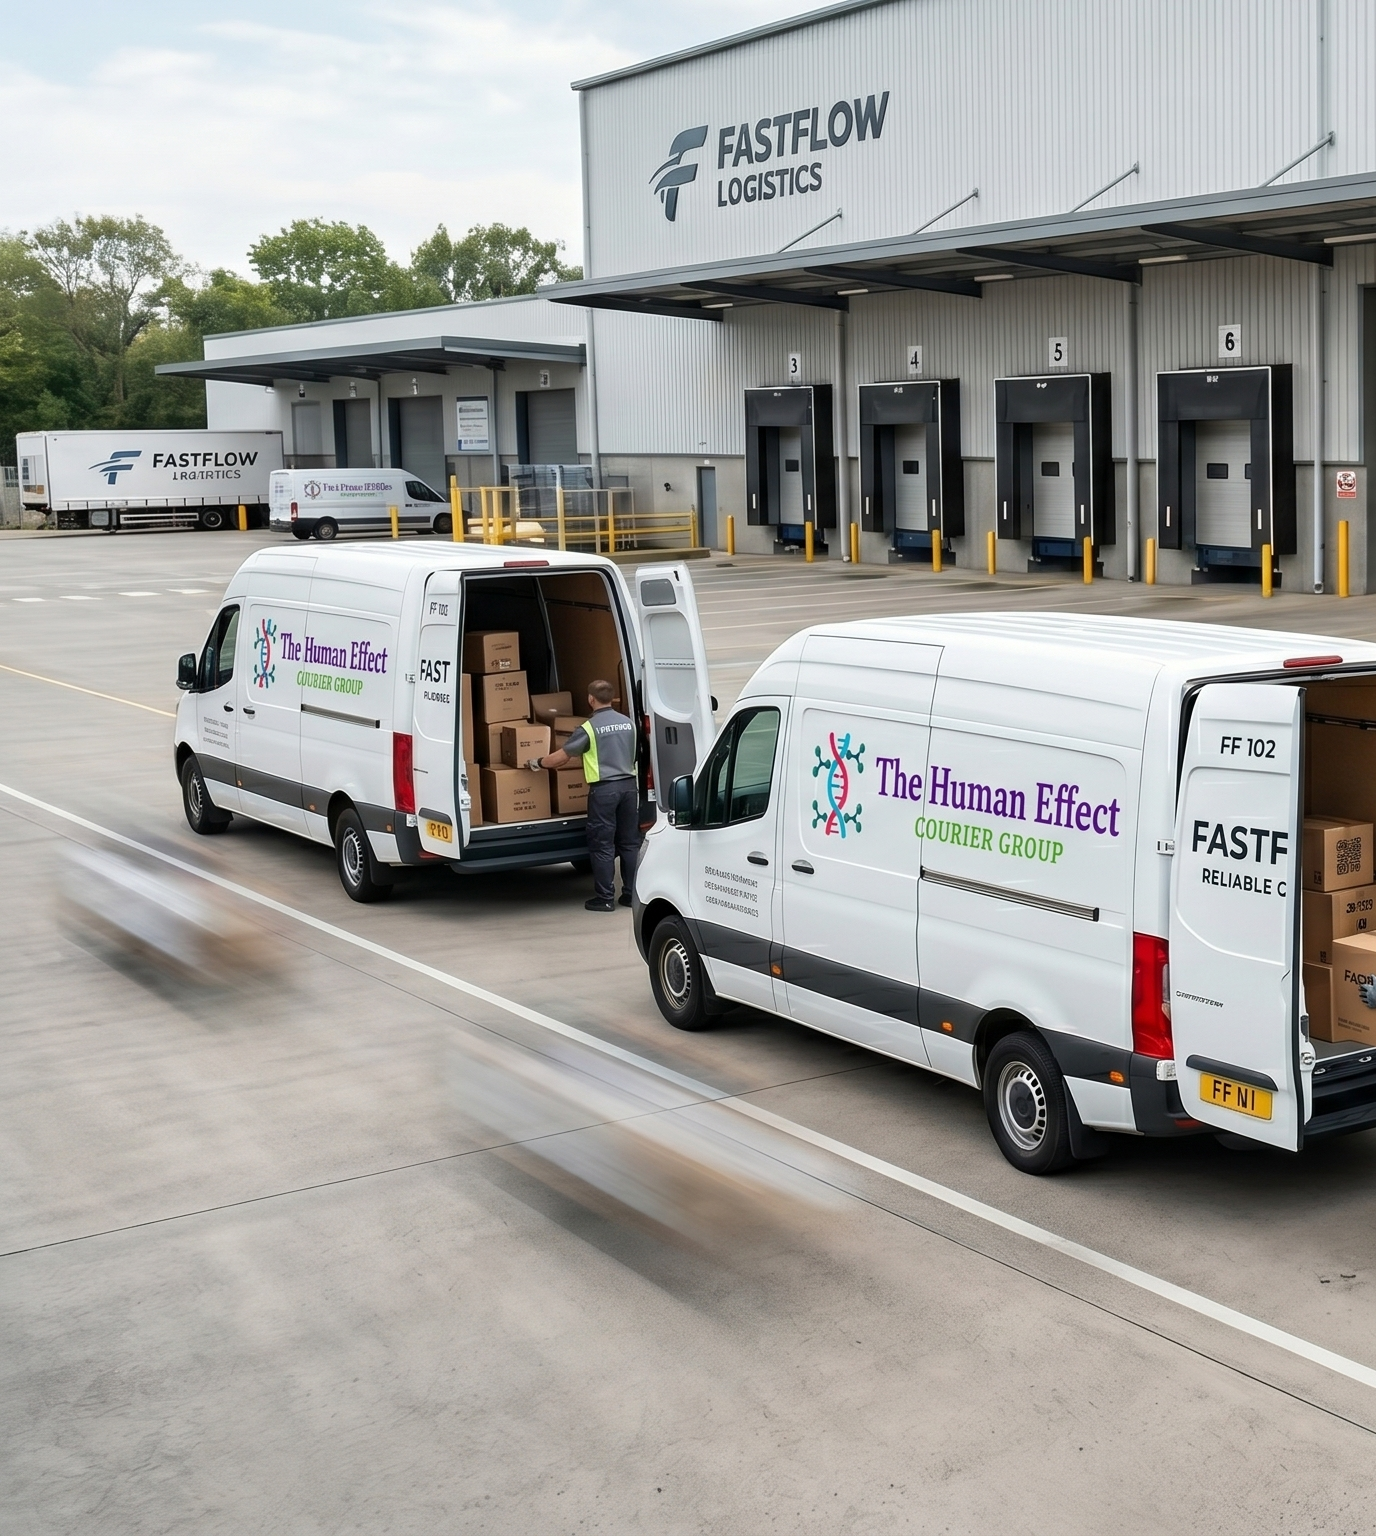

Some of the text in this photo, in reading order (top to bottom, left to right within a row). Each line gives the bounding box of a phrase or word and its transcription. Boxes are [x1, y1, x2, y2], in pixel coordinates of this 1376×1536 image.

[717, 91, 890, 170] FASTFLOW
[717, 162, 823, 208] LOGISTICS
[1053, 342, 1063, 362] 5
[1225, 331, 1235, 351] 6
[790, 357, 798, 374] 3
[910, 350, 920, 370] 4
[152, 451, 259, 468] FASTFLOW
[280, 632, 388, 674] The Human Effect
[420, 659, 451, 683] FAST
[334, 677, 363, 695] GROUP
[1220, 736, 1276, 759] FF 102
[875, 756, 1121, 837] The Human Effect
[914, 816, 1064, 865] COURIER GROUP
[1192, 819, 1289, 865] FASTF
[1202, 867, 1273, 895] RELIABLE
[1213, 1079, 1232, 1103] FF
